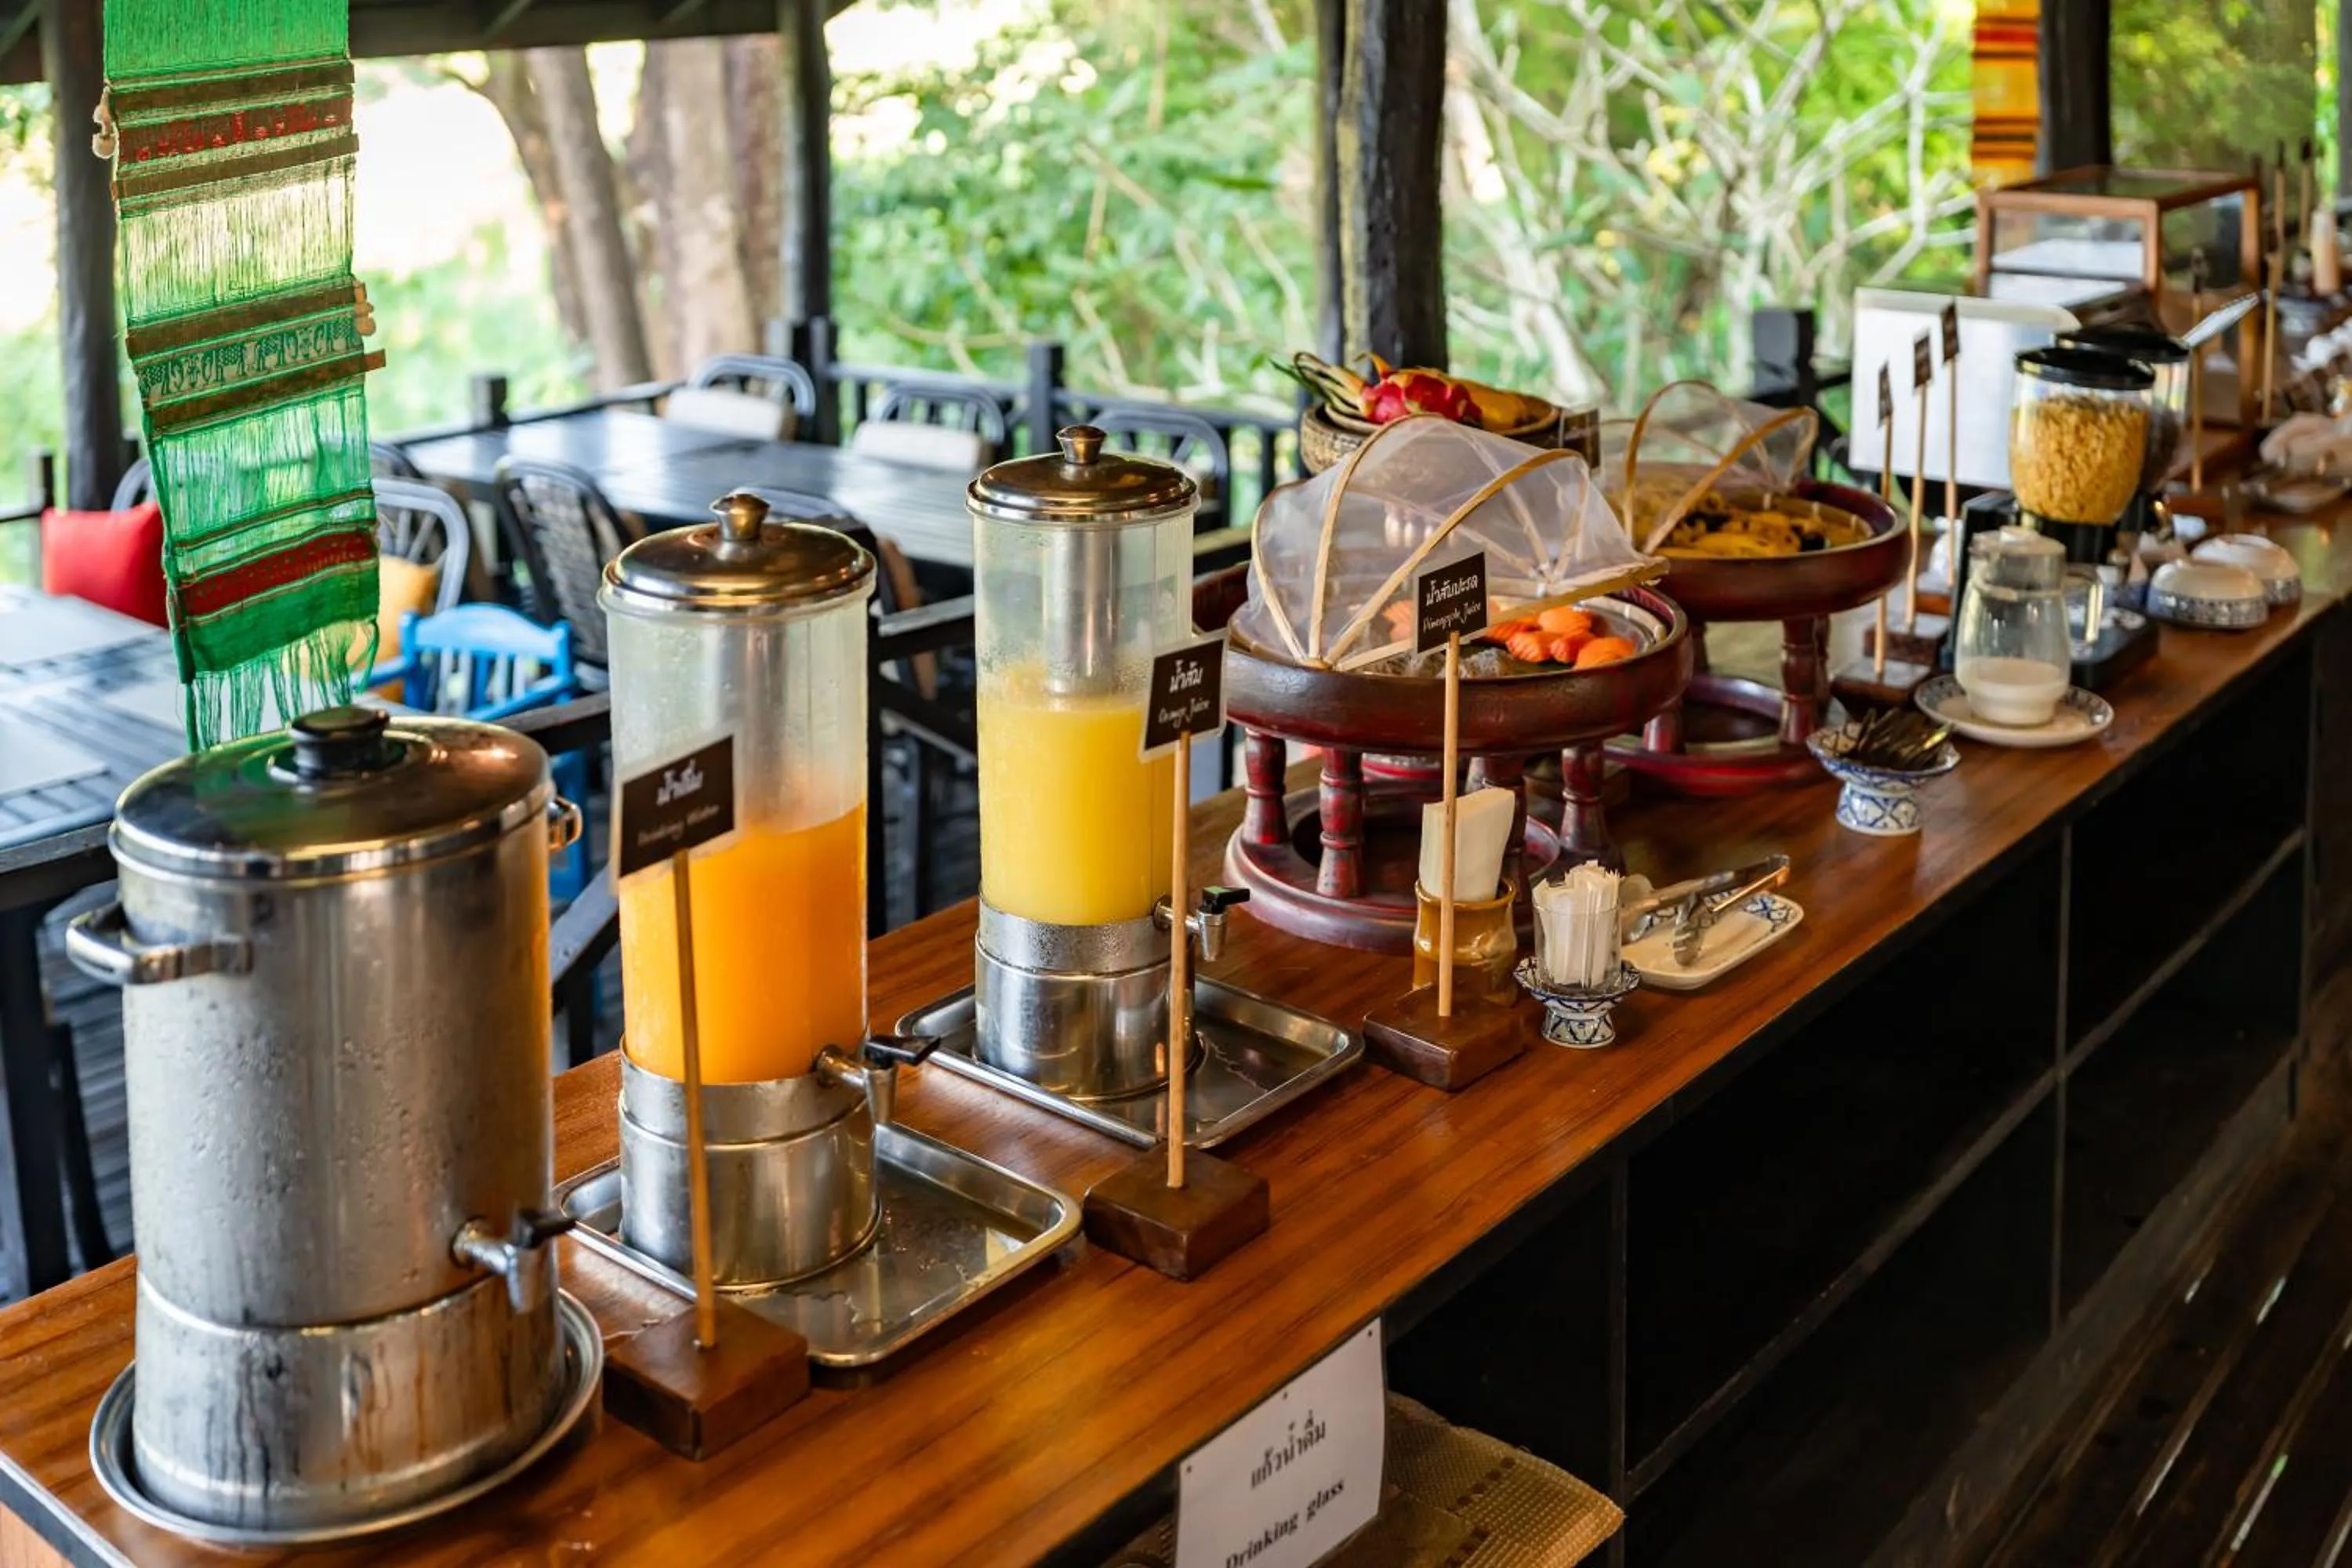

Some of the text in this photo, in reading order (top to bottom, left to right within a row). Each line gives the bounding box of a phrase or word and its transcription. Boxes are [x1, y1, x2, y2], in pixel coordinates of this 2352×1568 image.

[1168, 659, 1204, 695] น้ำส้ม
[1250, 1409, 1327, 1490] แก้วน้ำดื่ม
[1225, 1479, 1345, 1568] Drinking glass
